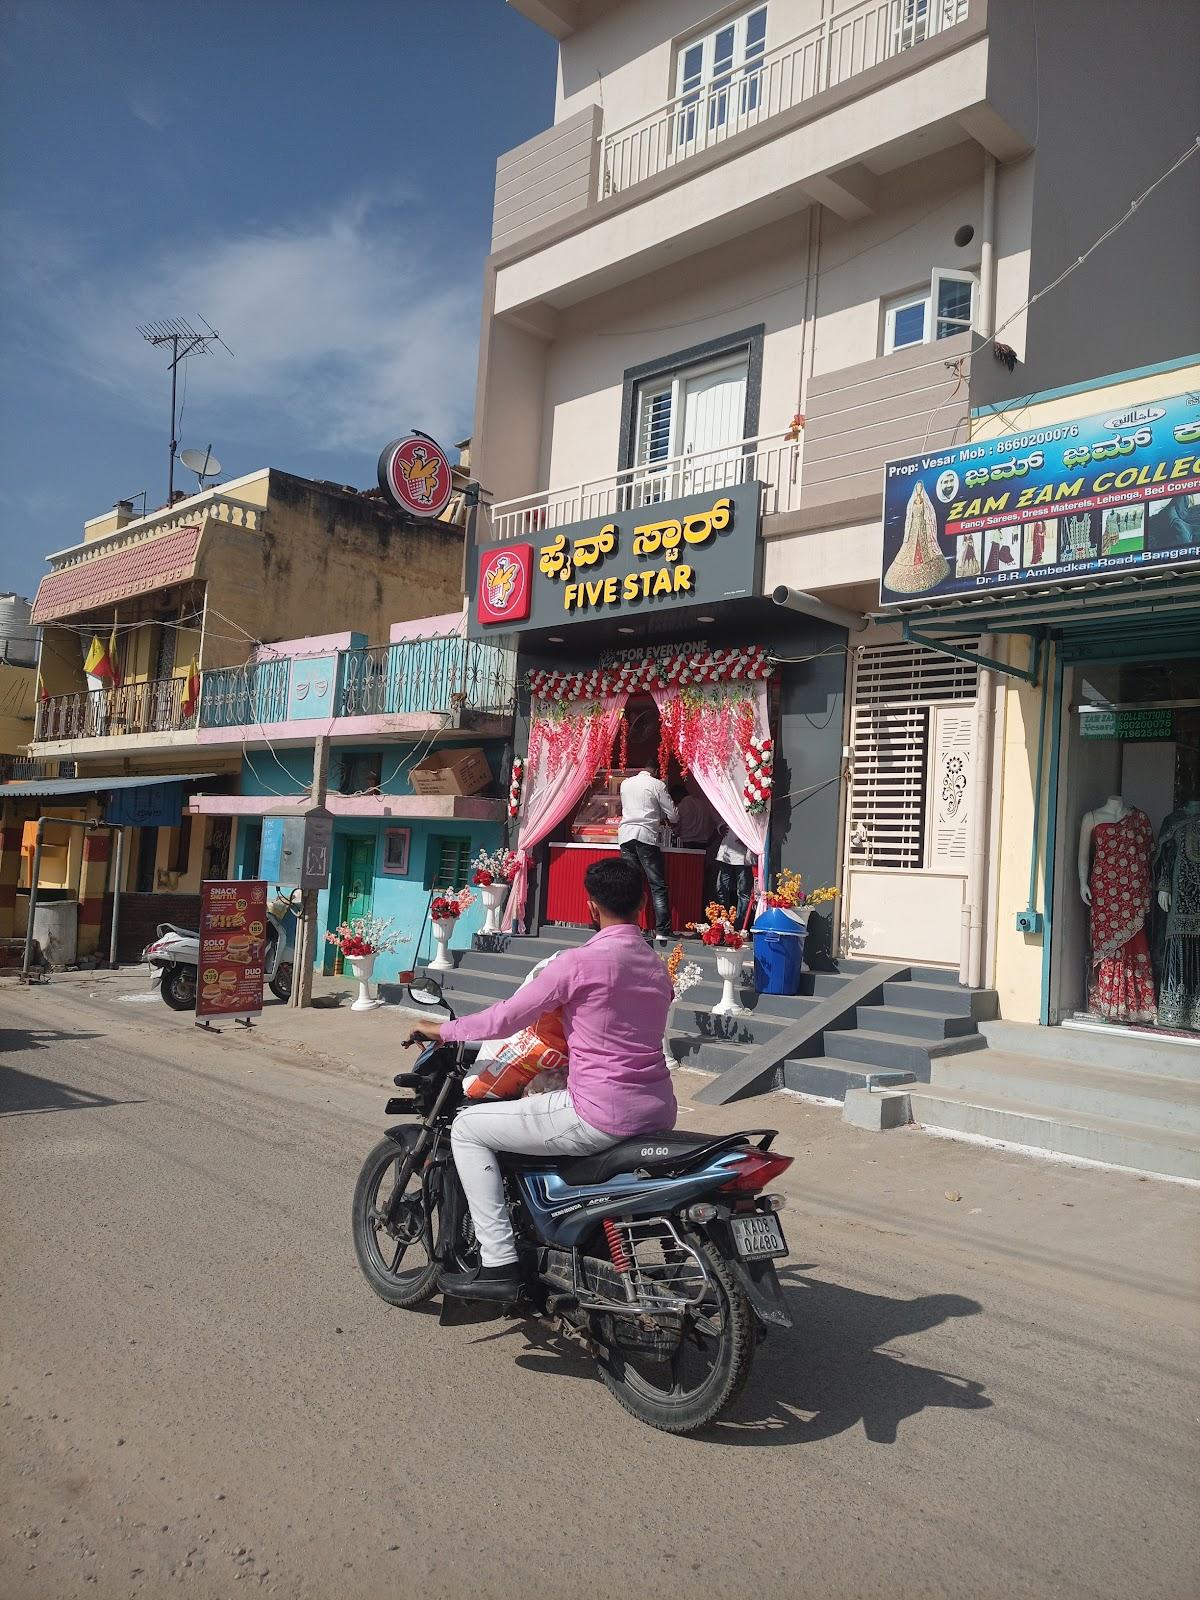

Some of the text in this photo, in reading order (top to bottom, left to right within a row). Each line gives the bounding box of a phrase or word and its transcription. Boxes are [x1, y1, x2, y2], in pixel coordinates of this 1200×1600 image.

[889, 464, 919, 477] Prop:
[922, 454, 956, 469] Vesar
[960, 447, 985, 461] Mob
[996, 425, 1079, 453] 8660200076
[947, 492, 1010, 521] ZAM
[1017, 478, 1085, 508] ZAM
[960, 519, 986, 530] Fancy
[986, 511, 1020, 525] Sarees,
[1022, 507, 1049, 518] Dress
[1096, 490, 1142, 505] Lehenga,
[1144, 485, 1165, 496] Bed
[1167, 481, 1200, 492] Cover
[539, 498, 731, 580] ಫೈವ್ ಸ್ಟಾರ್
[564, 564, 692, 610] FIVE STAR
[976, 577, 993, 585] Dr.
[997, 571, 1022, 581] B.R.
[1026, 562, 1093, 577] Ambedkar
[1097, 556, 1137, 568] Road,
[640, 1147, 669, 1157] GO GO
[741, 1218, 770, 1236] KA08
